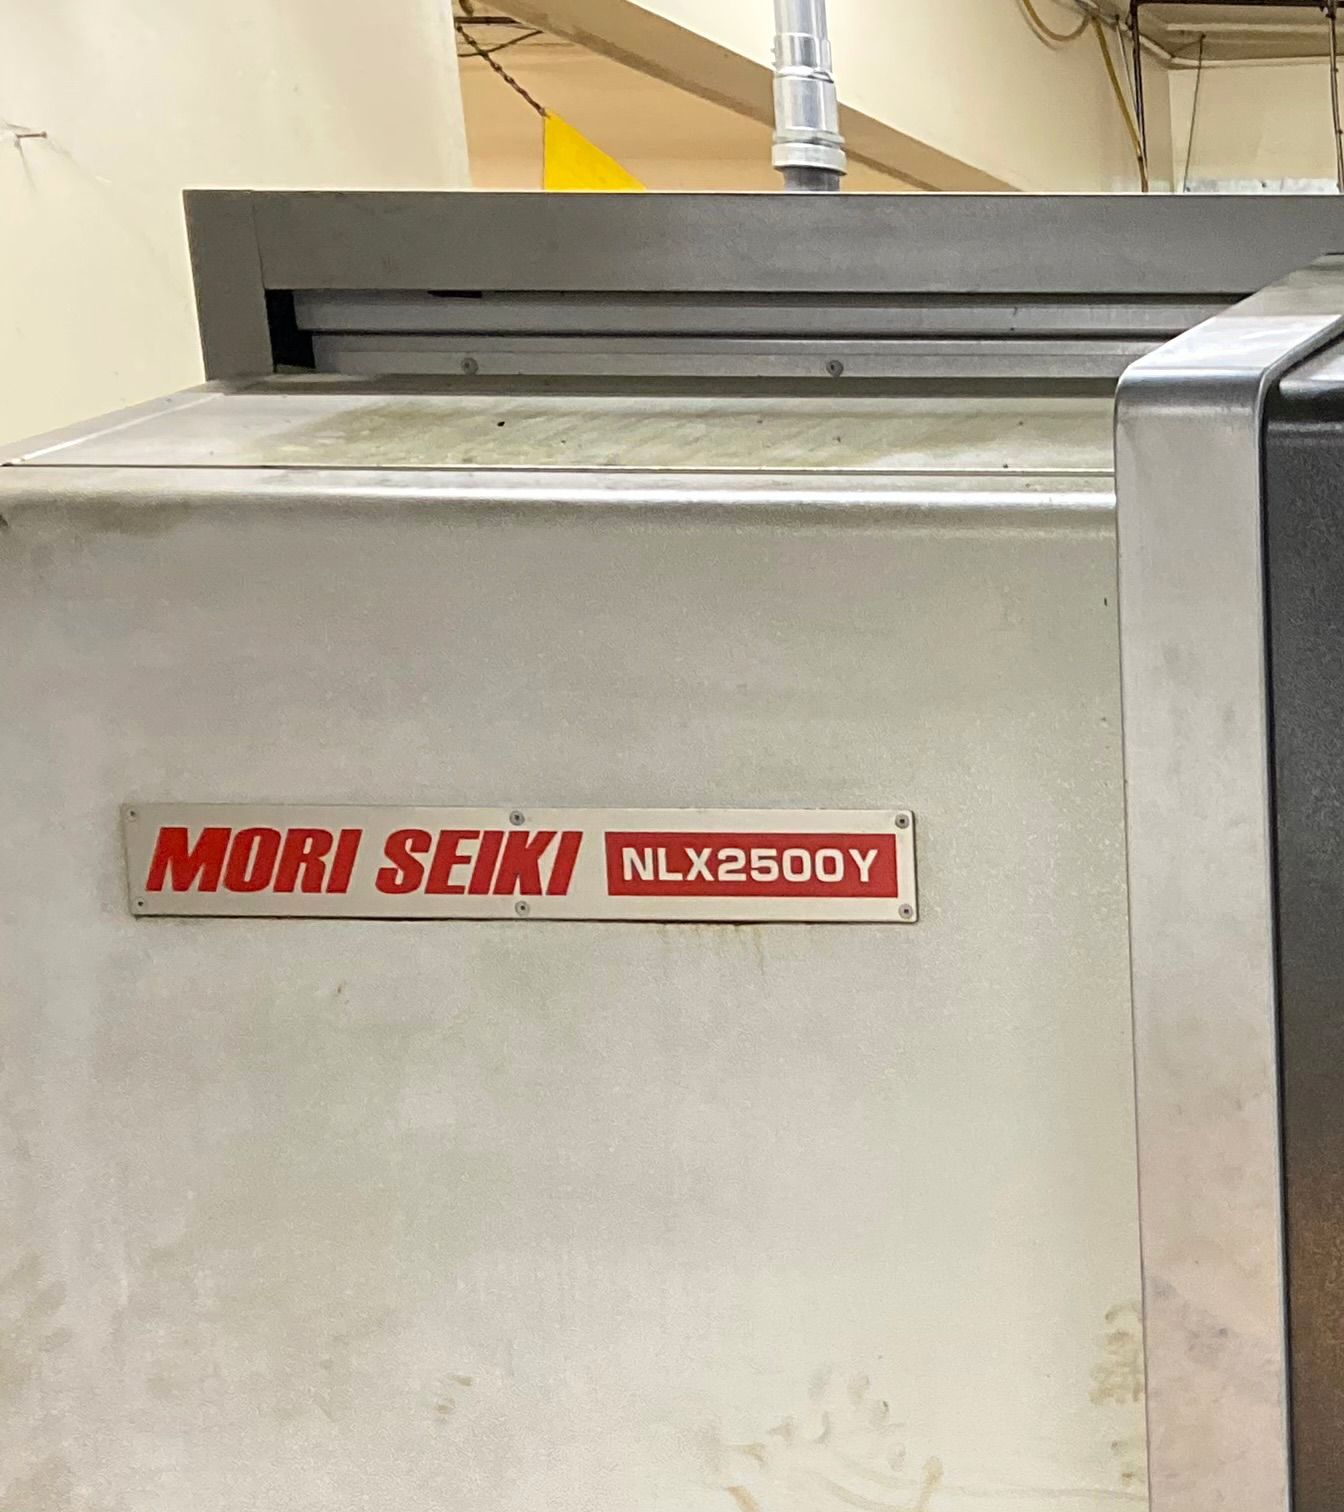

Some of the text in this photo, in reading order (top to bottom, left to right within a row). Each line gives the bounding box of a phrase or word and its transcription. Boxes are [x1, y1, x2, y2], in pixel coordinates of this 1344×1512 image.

[145, 826, 878, 896] MORI SEIKI NLX2500Y
